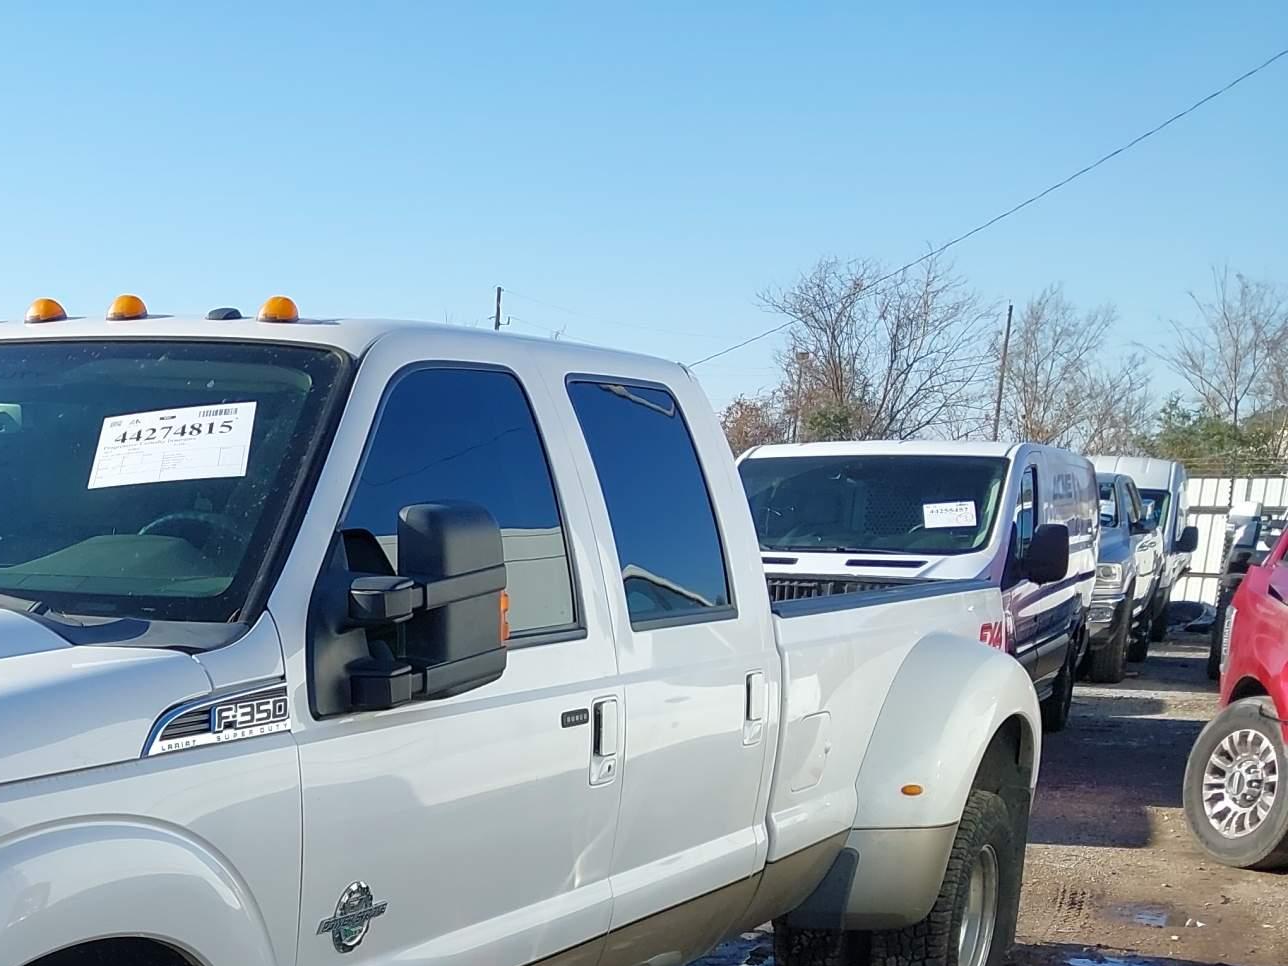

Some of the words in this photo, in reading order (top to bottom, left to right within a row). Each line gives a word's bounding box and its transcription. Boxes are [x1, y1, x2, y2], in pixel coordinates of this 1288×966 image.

[114, 419, 233, 444] 44274815
[214, 697, 289, 732] F-350
[216, 729, 254, 742] SUPER
[260, 722, 289, 733] DUTY
